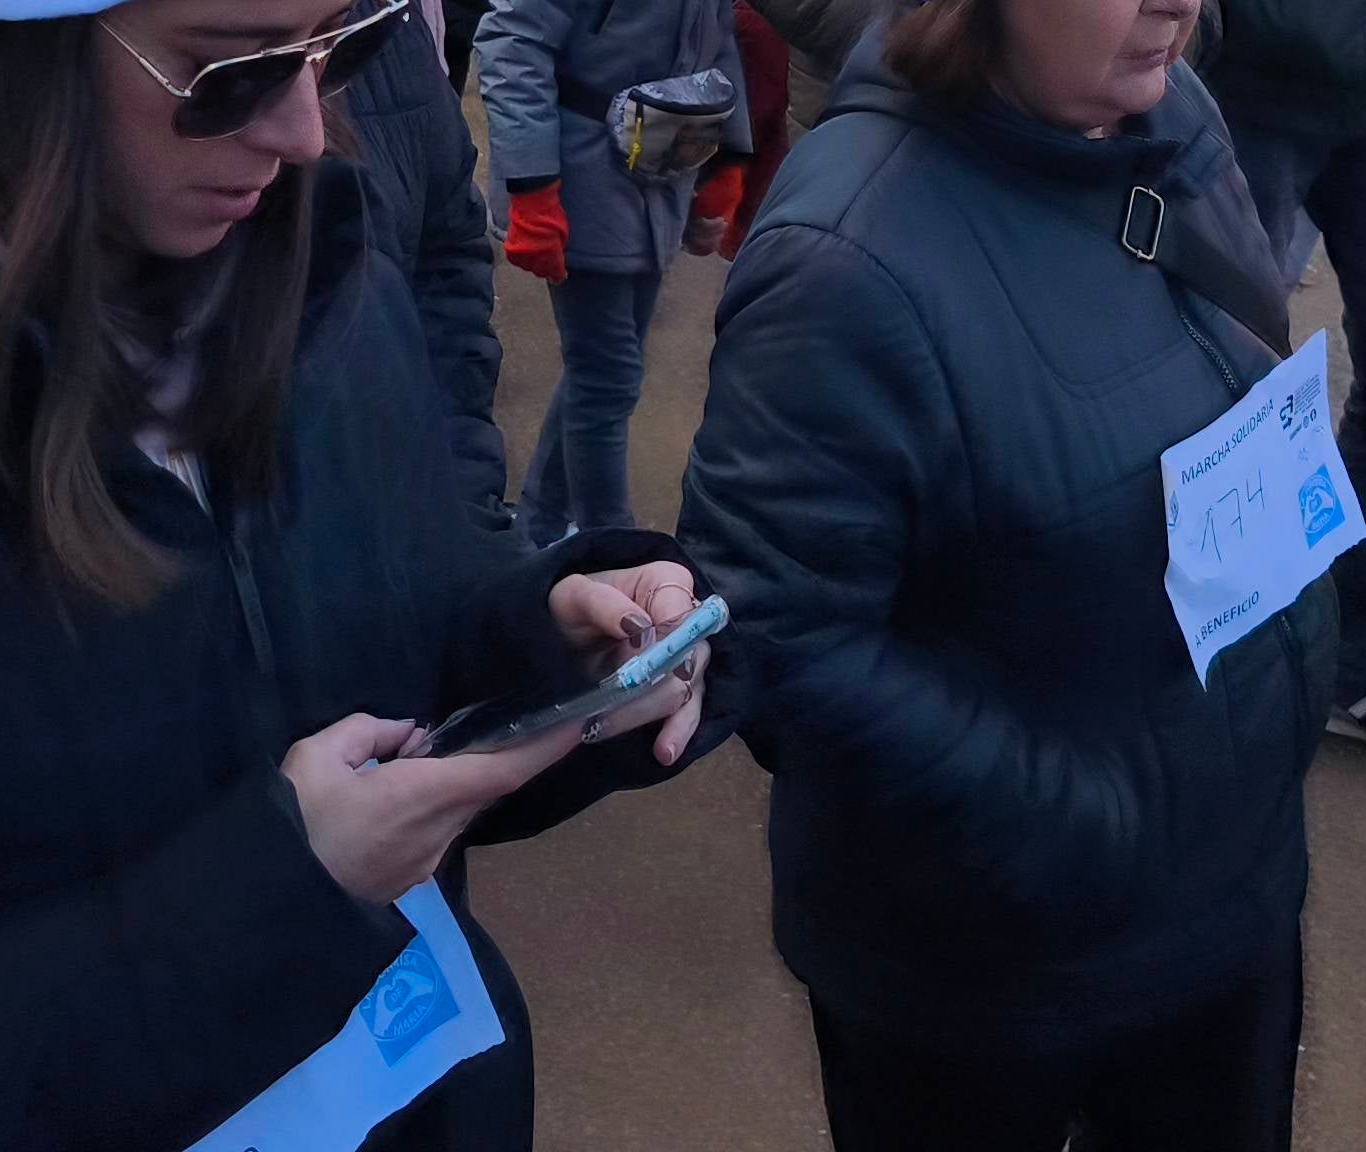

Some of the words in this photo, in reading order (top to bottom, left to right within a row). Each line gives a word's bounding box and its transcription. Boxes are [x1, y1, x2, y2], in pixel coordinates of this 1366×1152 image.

[1181, 441, 1231, 485] MARCHA
[1231, 398, 1274, 449] SOLIDARIA
[1200, 467, 1266, 564] 174
[1201, 591, 1259, 640] BENEFICIO
[393, 1004, 428, 1037] MARIA
